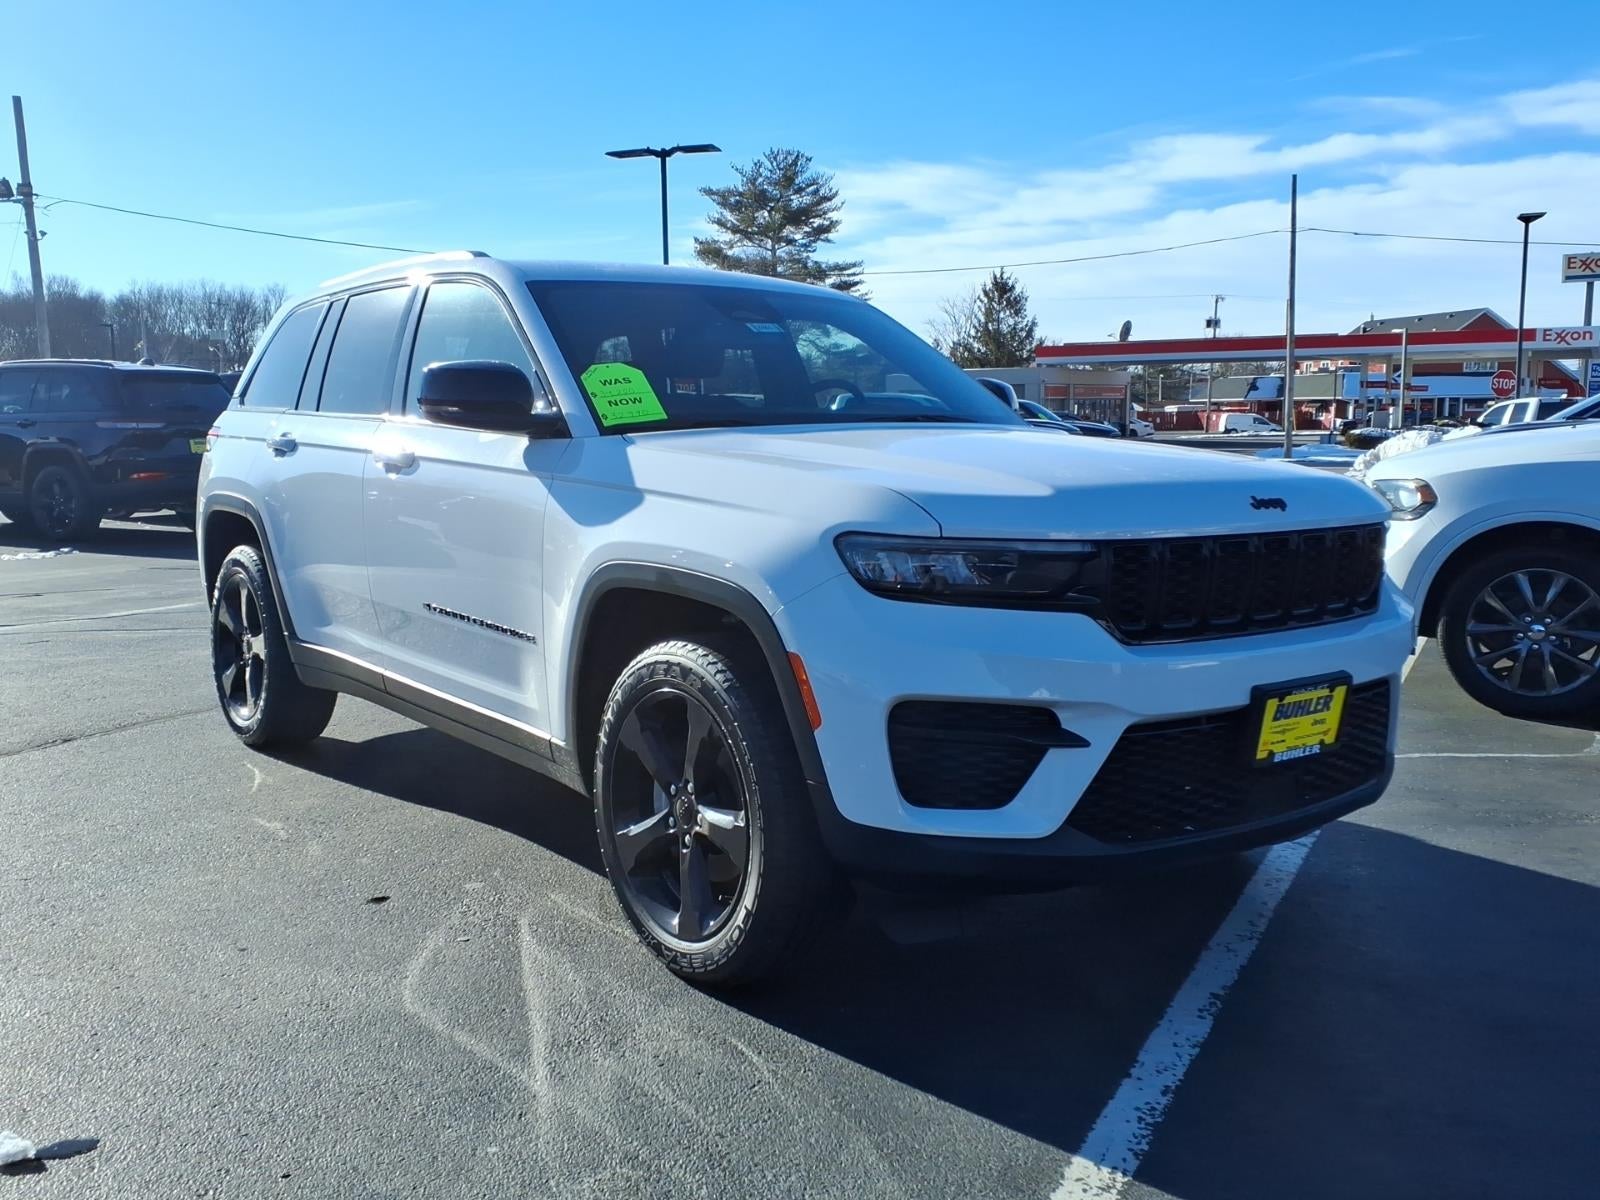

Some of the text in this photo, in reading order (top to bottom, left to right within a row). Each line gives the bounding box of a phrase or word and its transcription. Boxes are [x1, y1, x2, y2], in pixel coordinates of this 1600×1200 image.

[1542, 328, 1593, 346] Exxon
[599, 377, 632, 386] WAS
[1492, 378, 1516, 390] STOP
[607, 397, 643, 407] NOW
[1273, 744, 1321, 762] BUHLER
